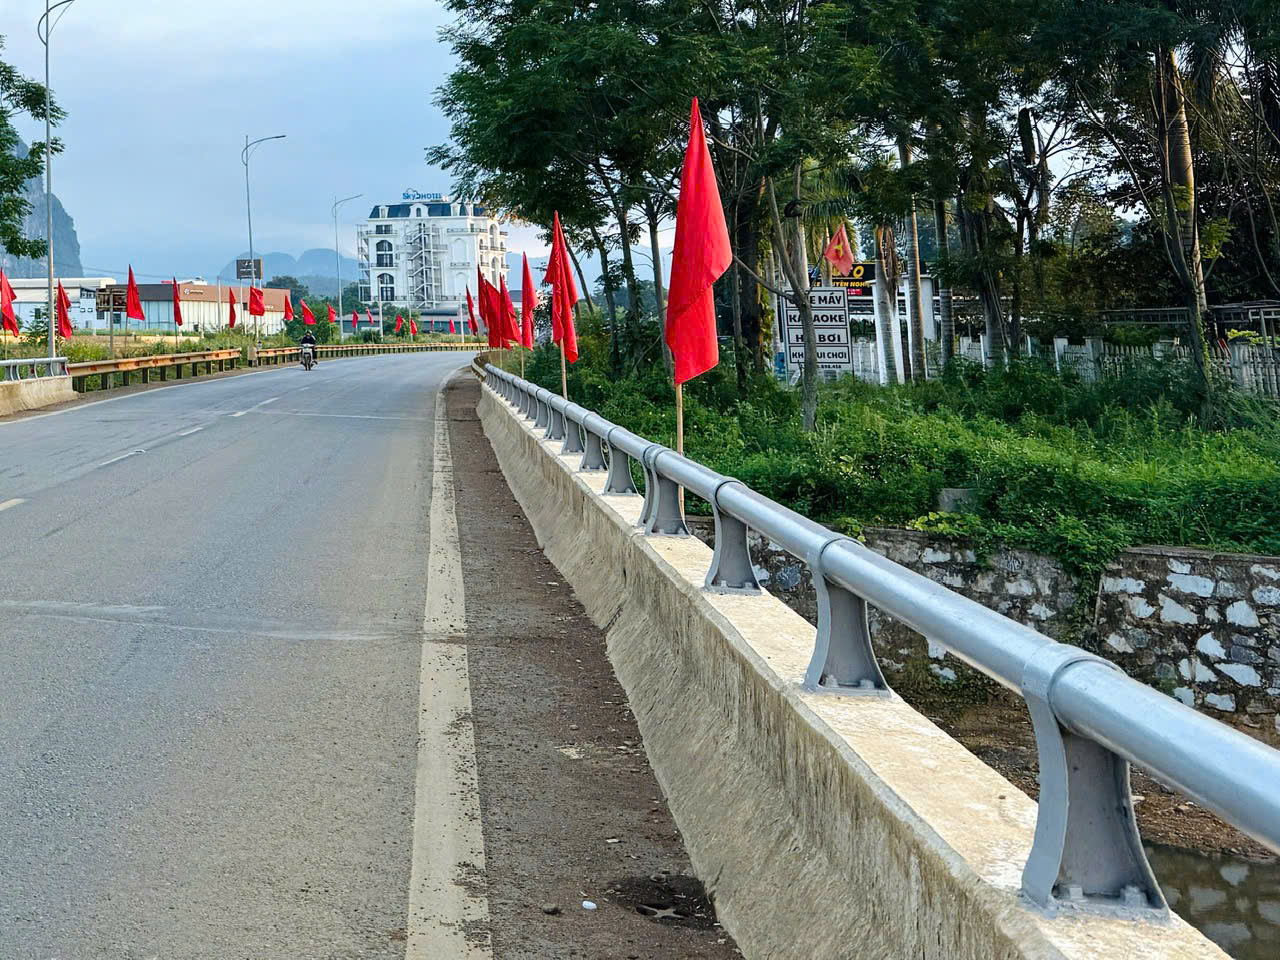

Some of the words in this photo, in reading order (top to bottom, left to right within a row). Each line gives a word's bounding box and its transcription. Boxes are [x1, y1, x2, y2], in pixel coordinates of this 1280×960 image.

[421, 192, 442, 200] HOTEL
[818, 292, 842, 305] MÁY
[789, 314, 845, 323] KAAOKE
[818, 333, 841, 343] BƠI
[827, 350, 847, 359] CHƠI
